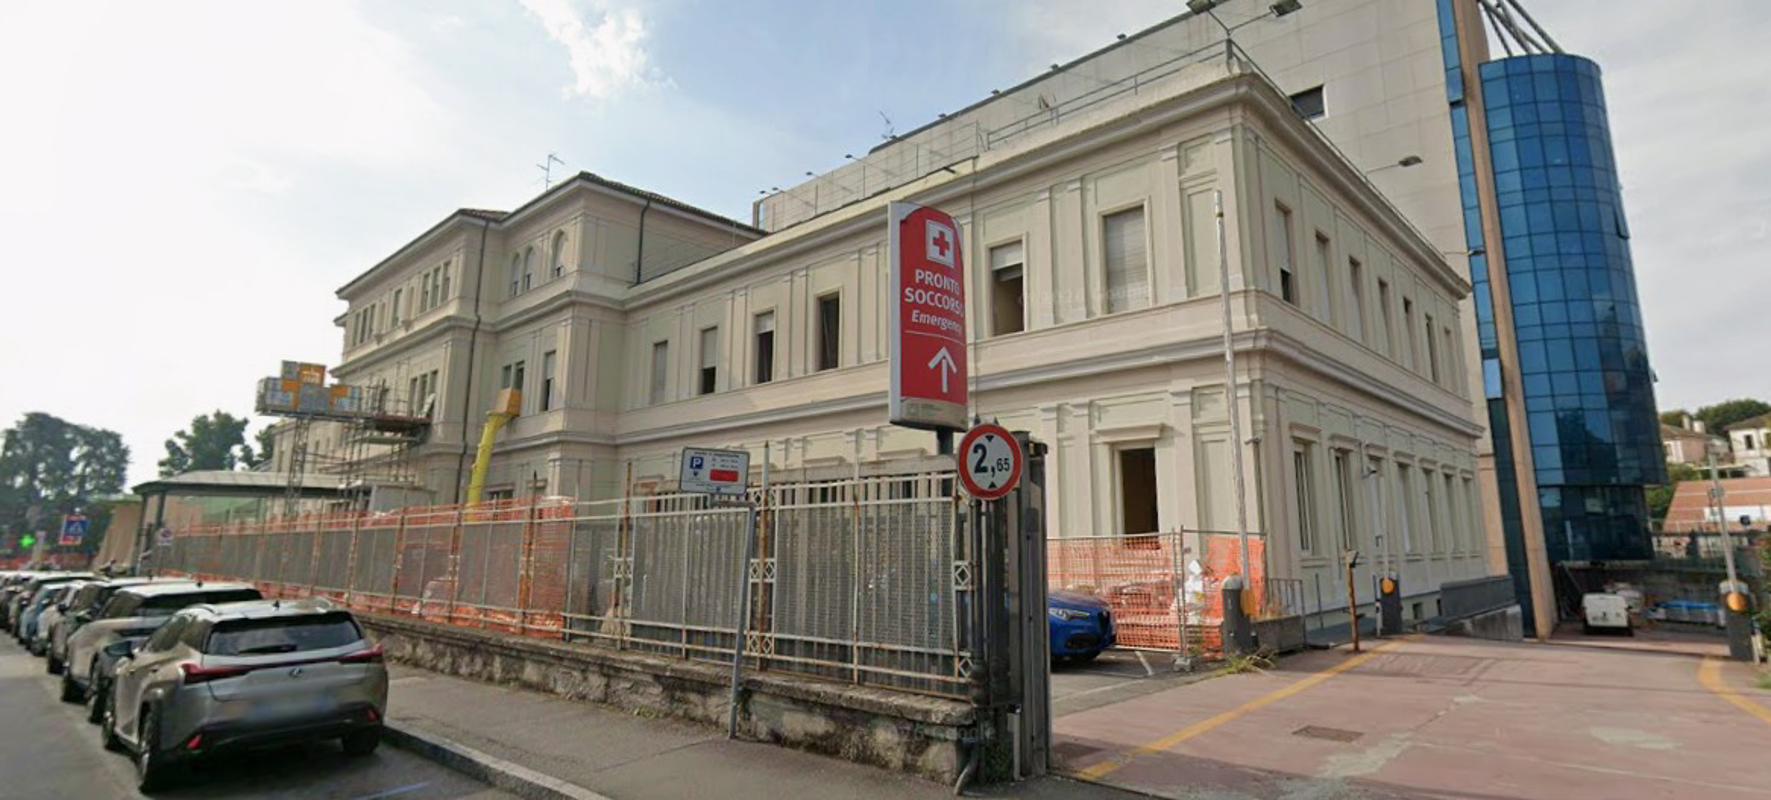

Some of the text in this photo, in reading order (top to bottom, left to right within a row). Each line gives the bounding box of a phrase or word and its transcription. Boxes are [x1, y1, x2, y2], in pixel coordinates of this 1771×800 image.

[915, 268, 960, 295] PRONTO
[911, 309, 963, 336] Emergency
[693, 458, 702, 468] P
[972, 442, 1010, 478] 2,65
